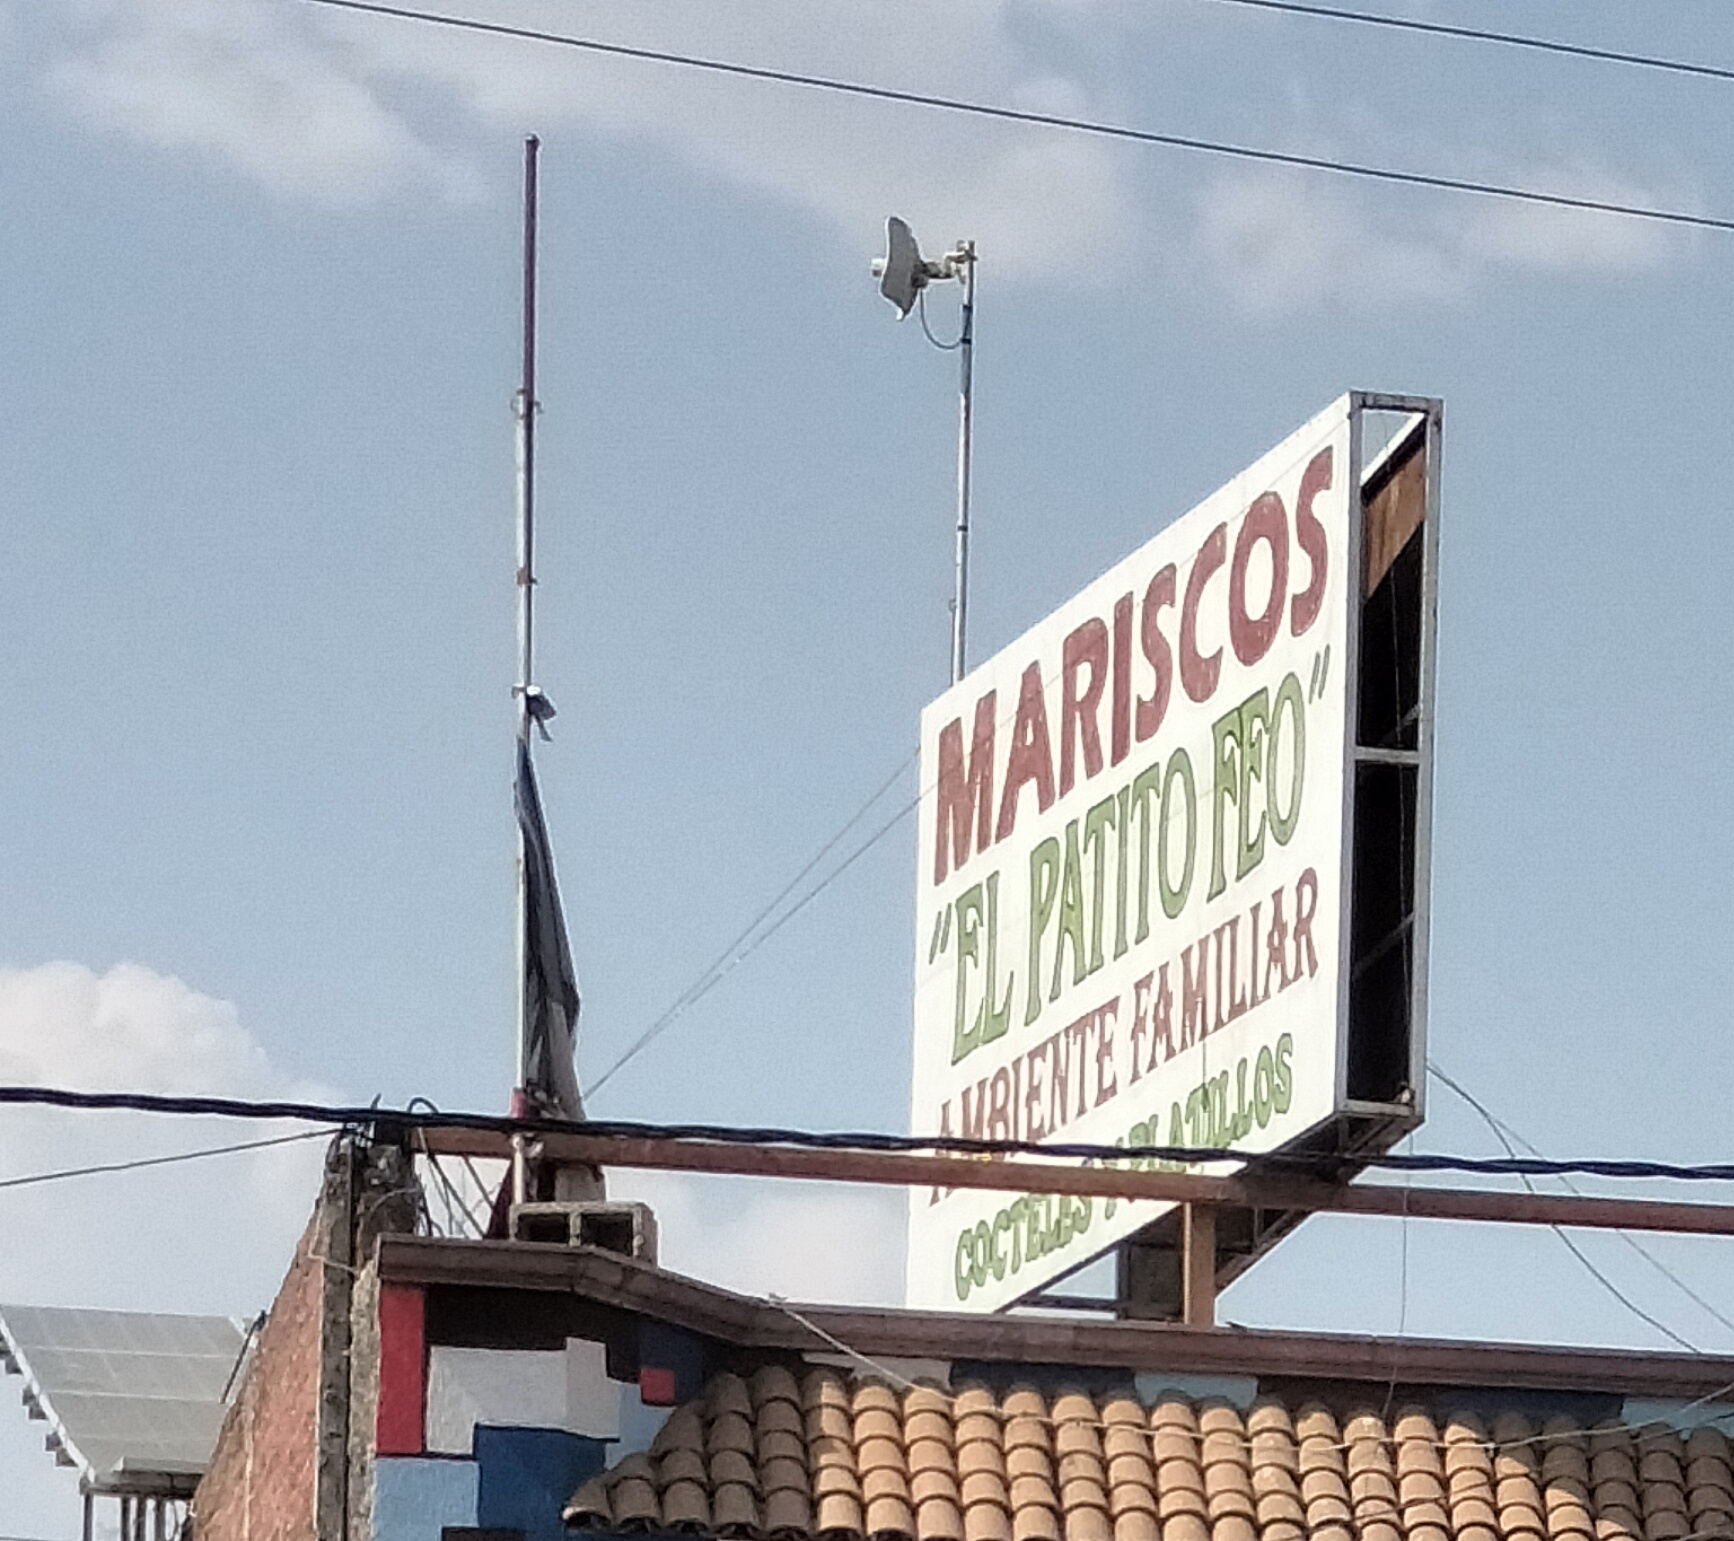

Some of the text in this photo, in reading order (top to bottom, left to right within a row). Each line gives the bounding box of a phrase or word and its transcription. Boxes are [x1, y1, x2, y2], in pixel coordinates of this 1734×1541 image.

[933, 445, 1335, 887] MARISCOS
[1024, 746, 1196, 1028] PATITO
[1206, 643, 1331, 906] FEO"
[1129, 867, 1319, 1085] FAMILIAR
[955, 1164, 1093, 1300] COCTELES
